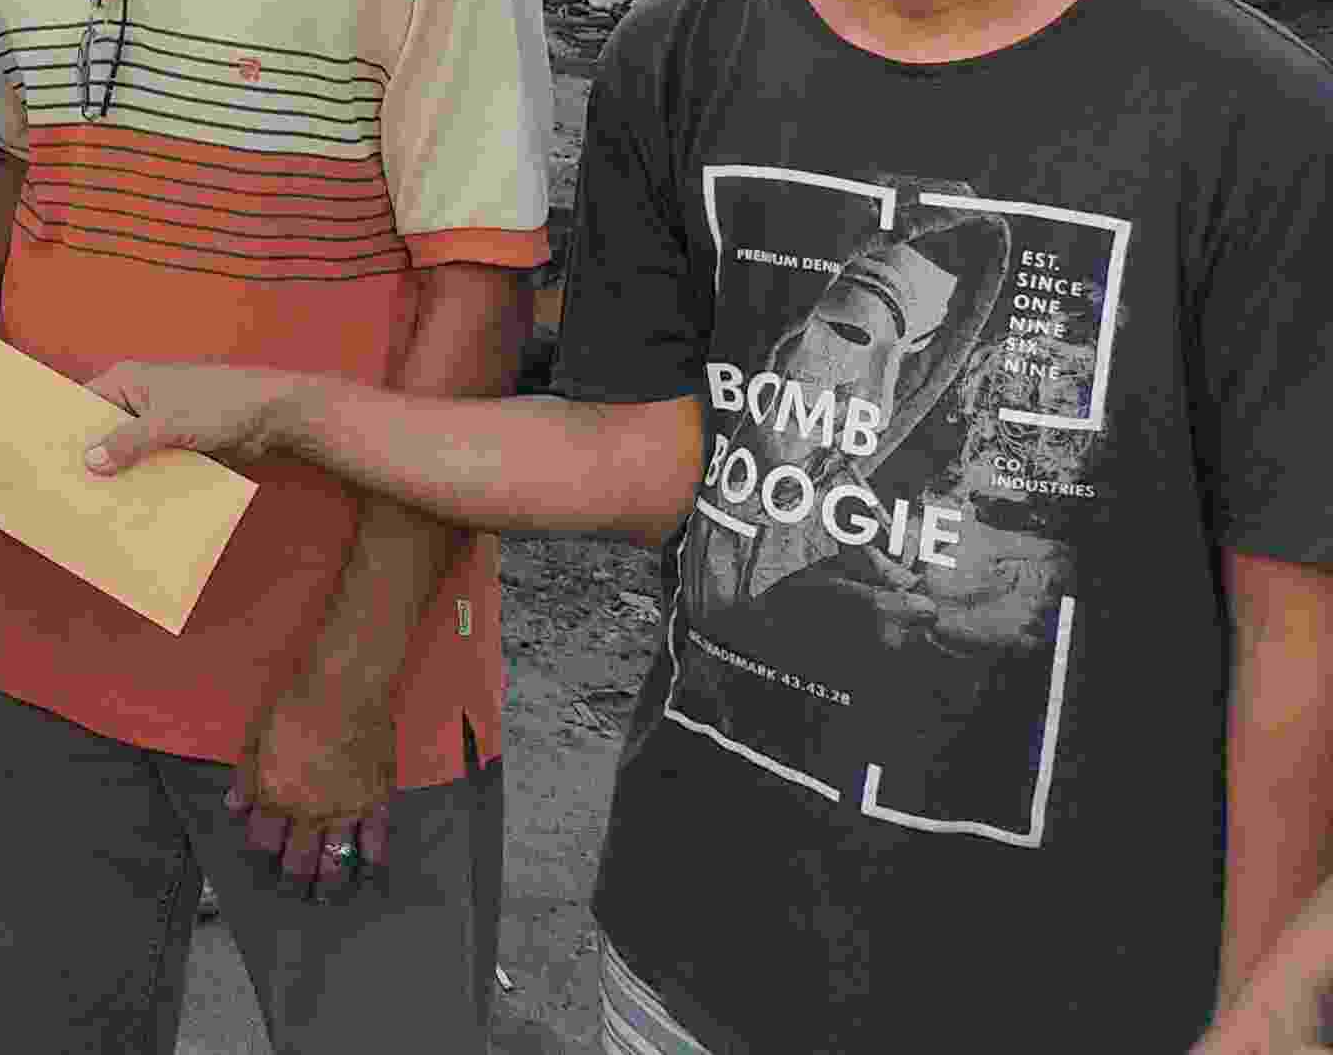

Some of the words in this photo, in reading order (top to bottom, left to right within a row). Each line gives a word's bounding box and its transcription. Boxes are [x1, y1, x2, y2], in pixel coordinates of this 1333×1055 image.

[1021, 249, 1061, 272] EST.
[1015, 272, 1083, 297] SINCE
[1013, 294, 1061, 315] ONE
[1009, 315, 1068, 339] NINE
[1005, 337, 1039, 356] SIX
[1004, 358, 1061, 380] NINE
[706, 362, 881, 456] BOMB
[991, 473, 1096, 498] INDUSTRIES
[705, 433, 962, 569] BOOGIE
